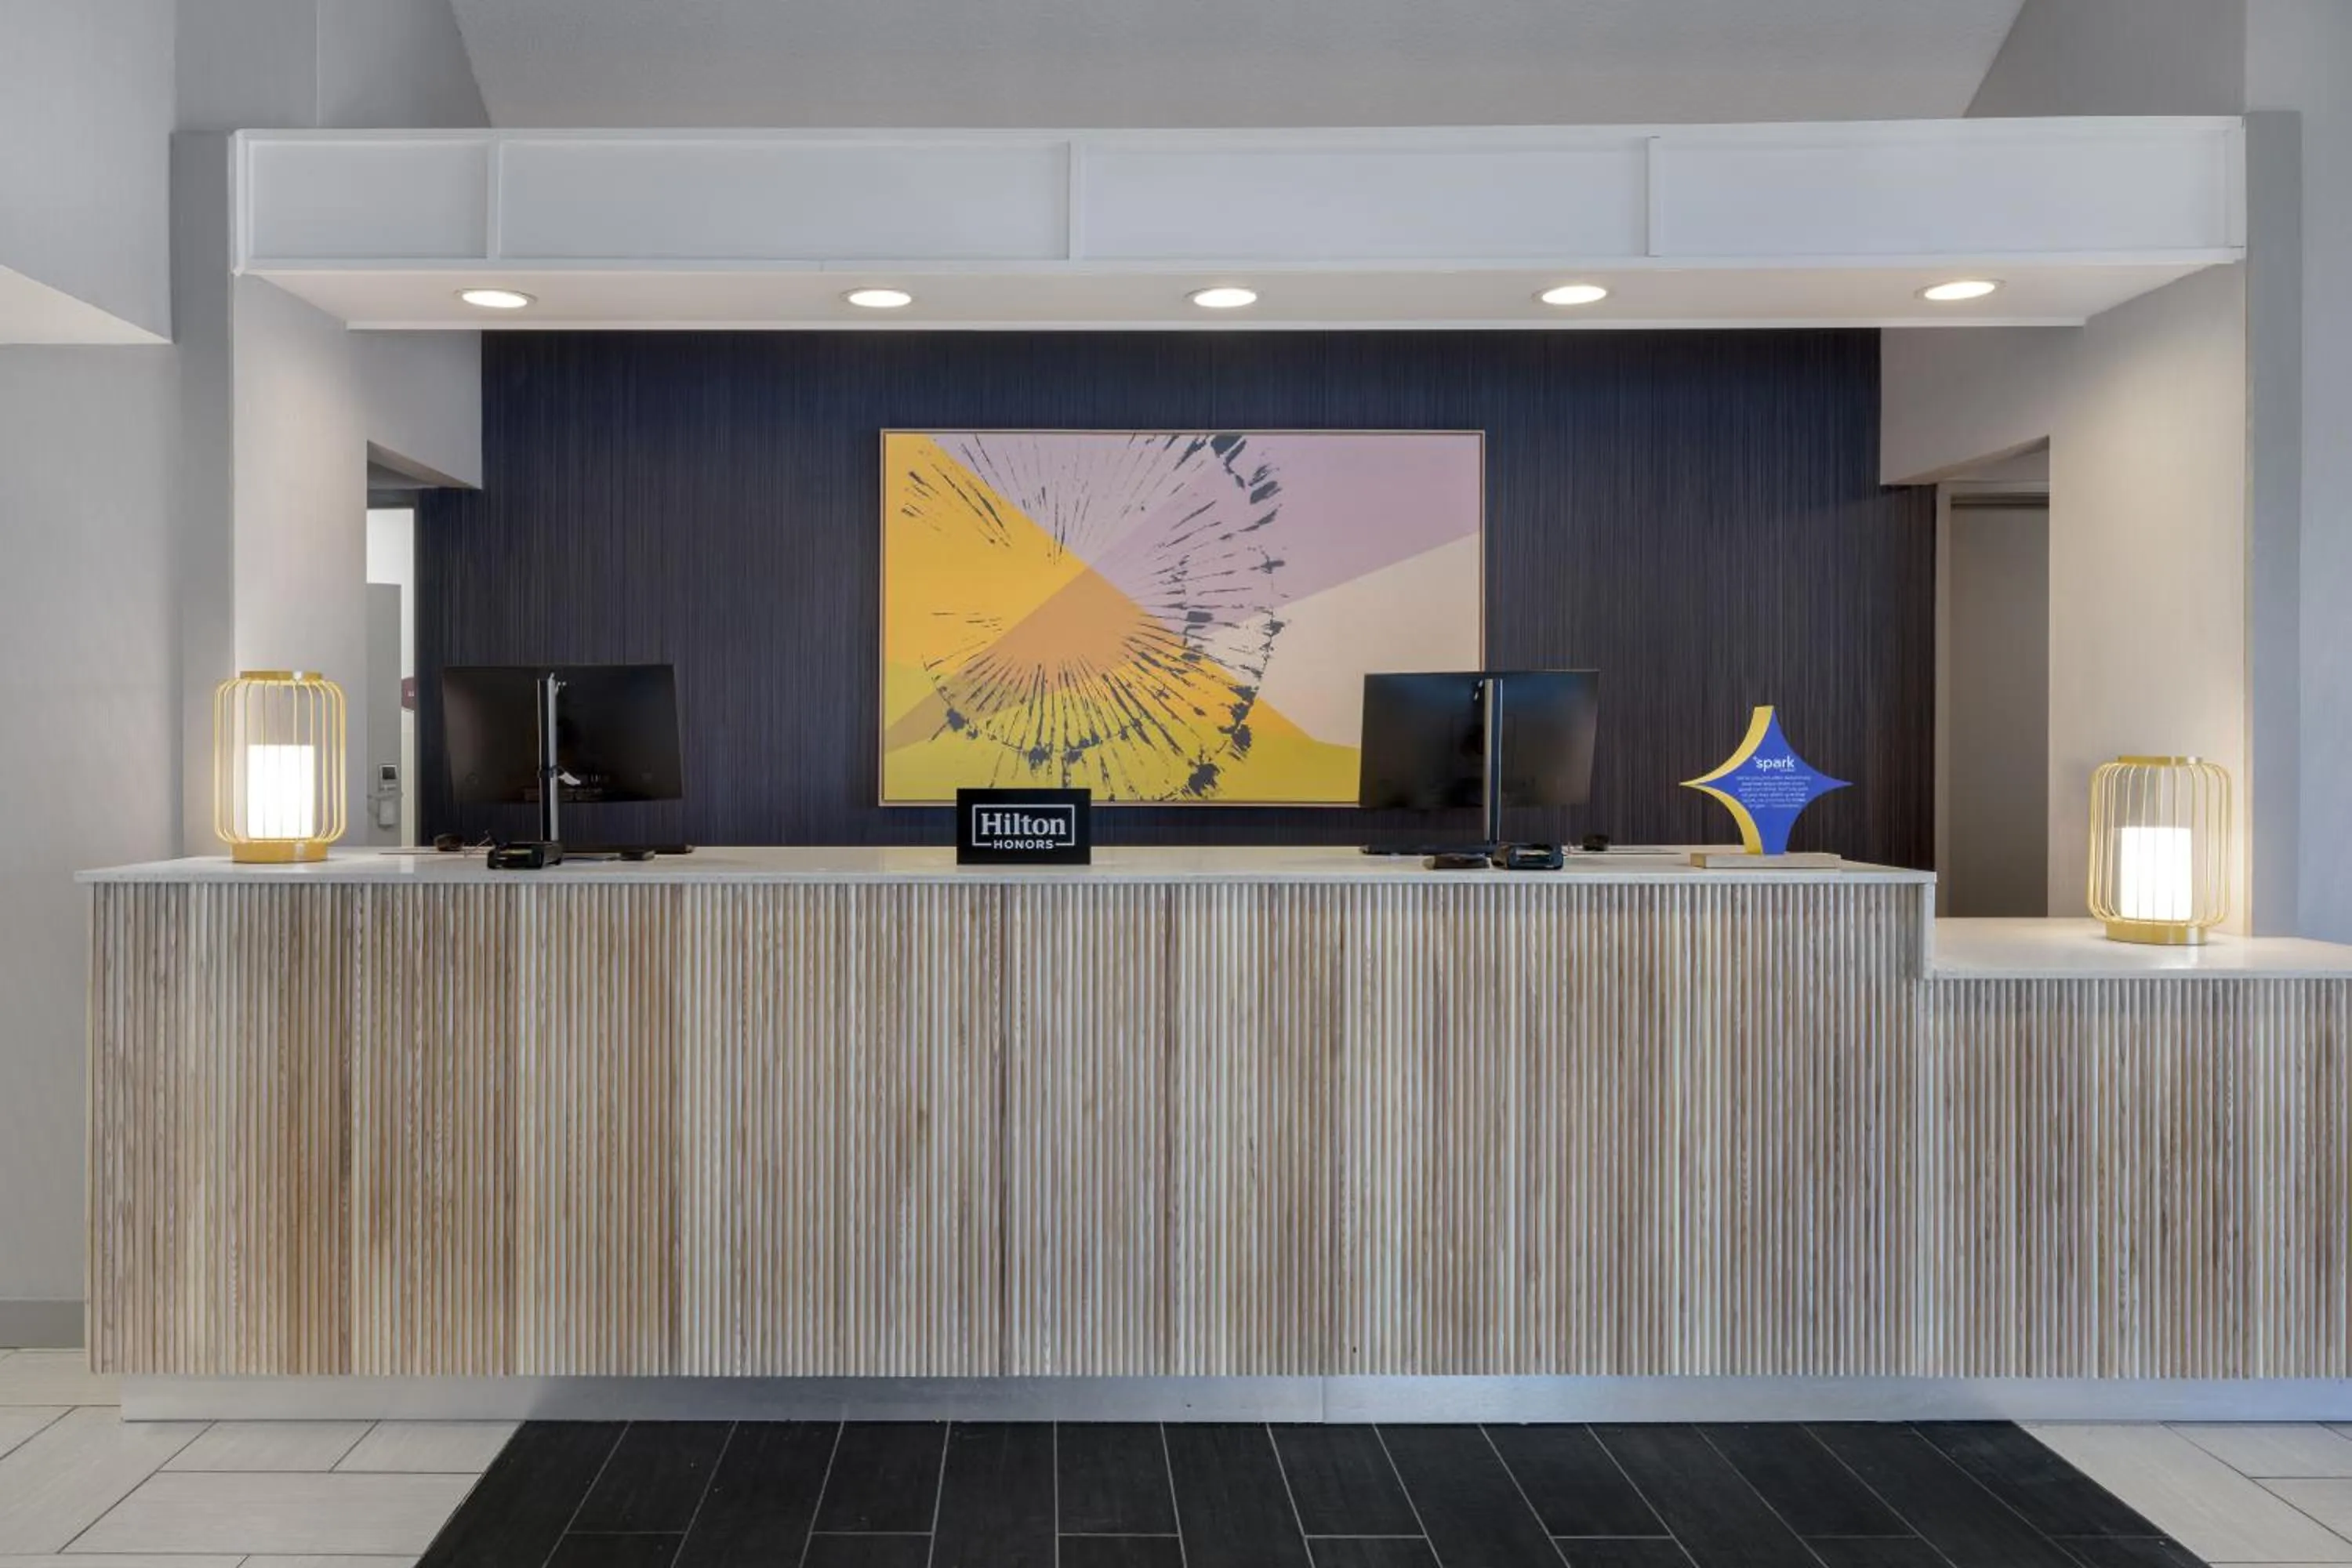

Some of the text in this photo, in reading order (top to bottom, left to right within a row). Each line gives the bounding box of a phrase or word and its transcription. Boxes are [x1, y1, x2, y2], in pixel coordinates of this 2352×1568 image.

[1755, 756, 1795, 772] spark
[981, 812, 1066, 836] Hilton
[993, 840, 1054, 850] HONORS
